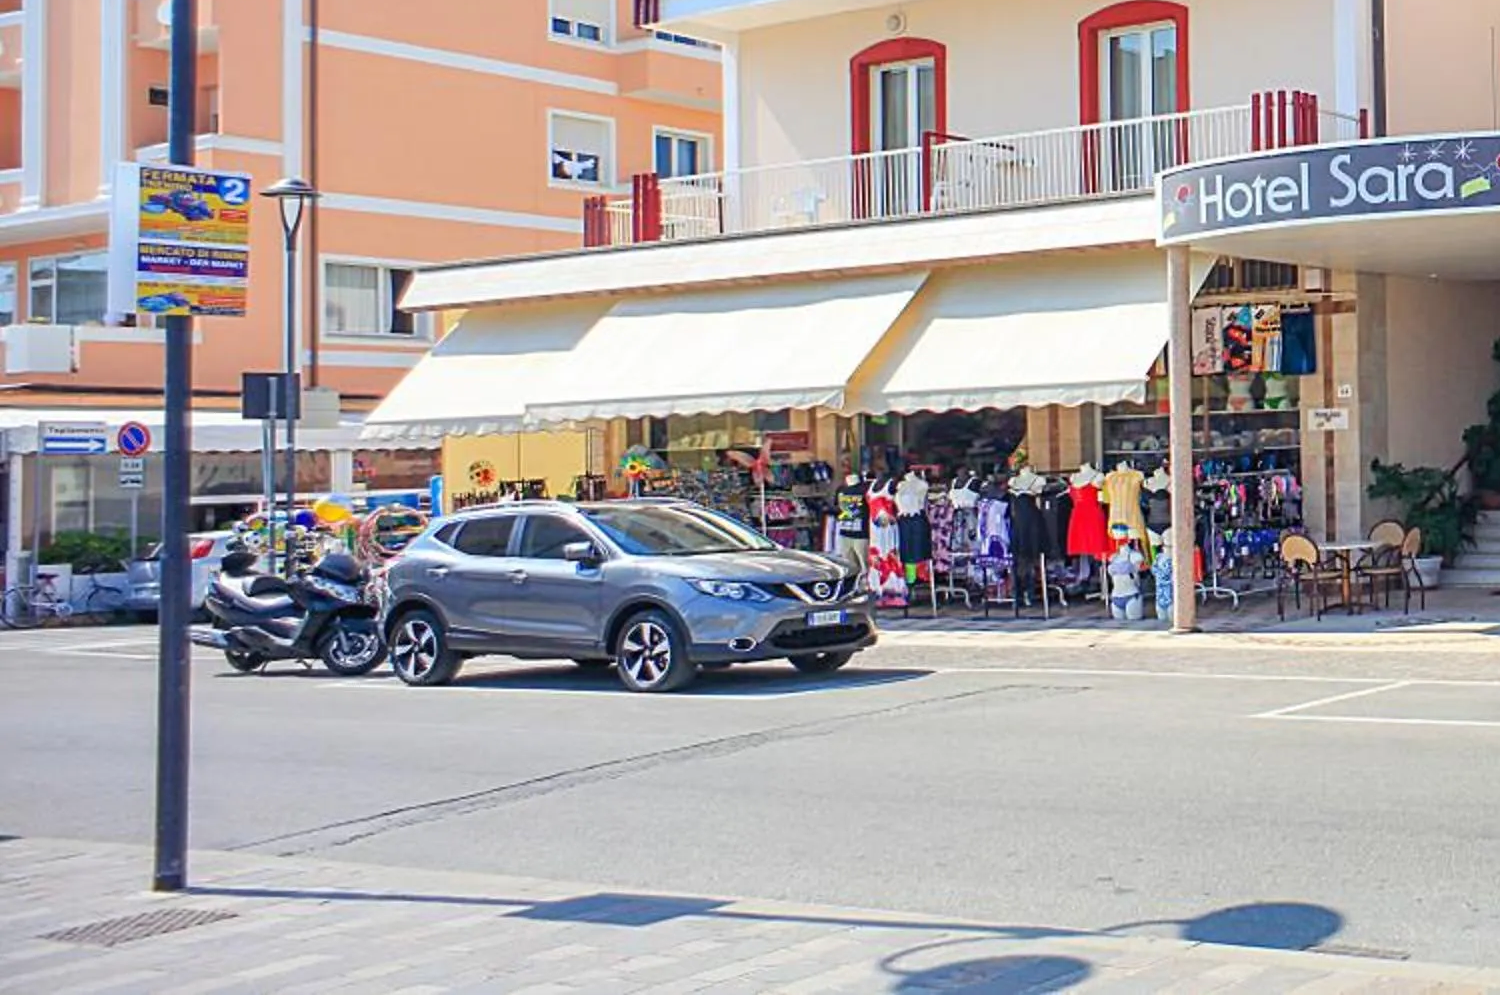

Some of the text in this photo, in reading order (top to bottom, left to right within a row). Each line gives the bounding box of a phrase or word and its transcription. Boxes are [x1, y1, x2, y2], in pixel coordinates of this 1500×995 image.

[143, 169, 216, 184] FERMATA
[1199, 154, 1455, 224] Hotel Sara
[223, 178, 246, 203] 2
